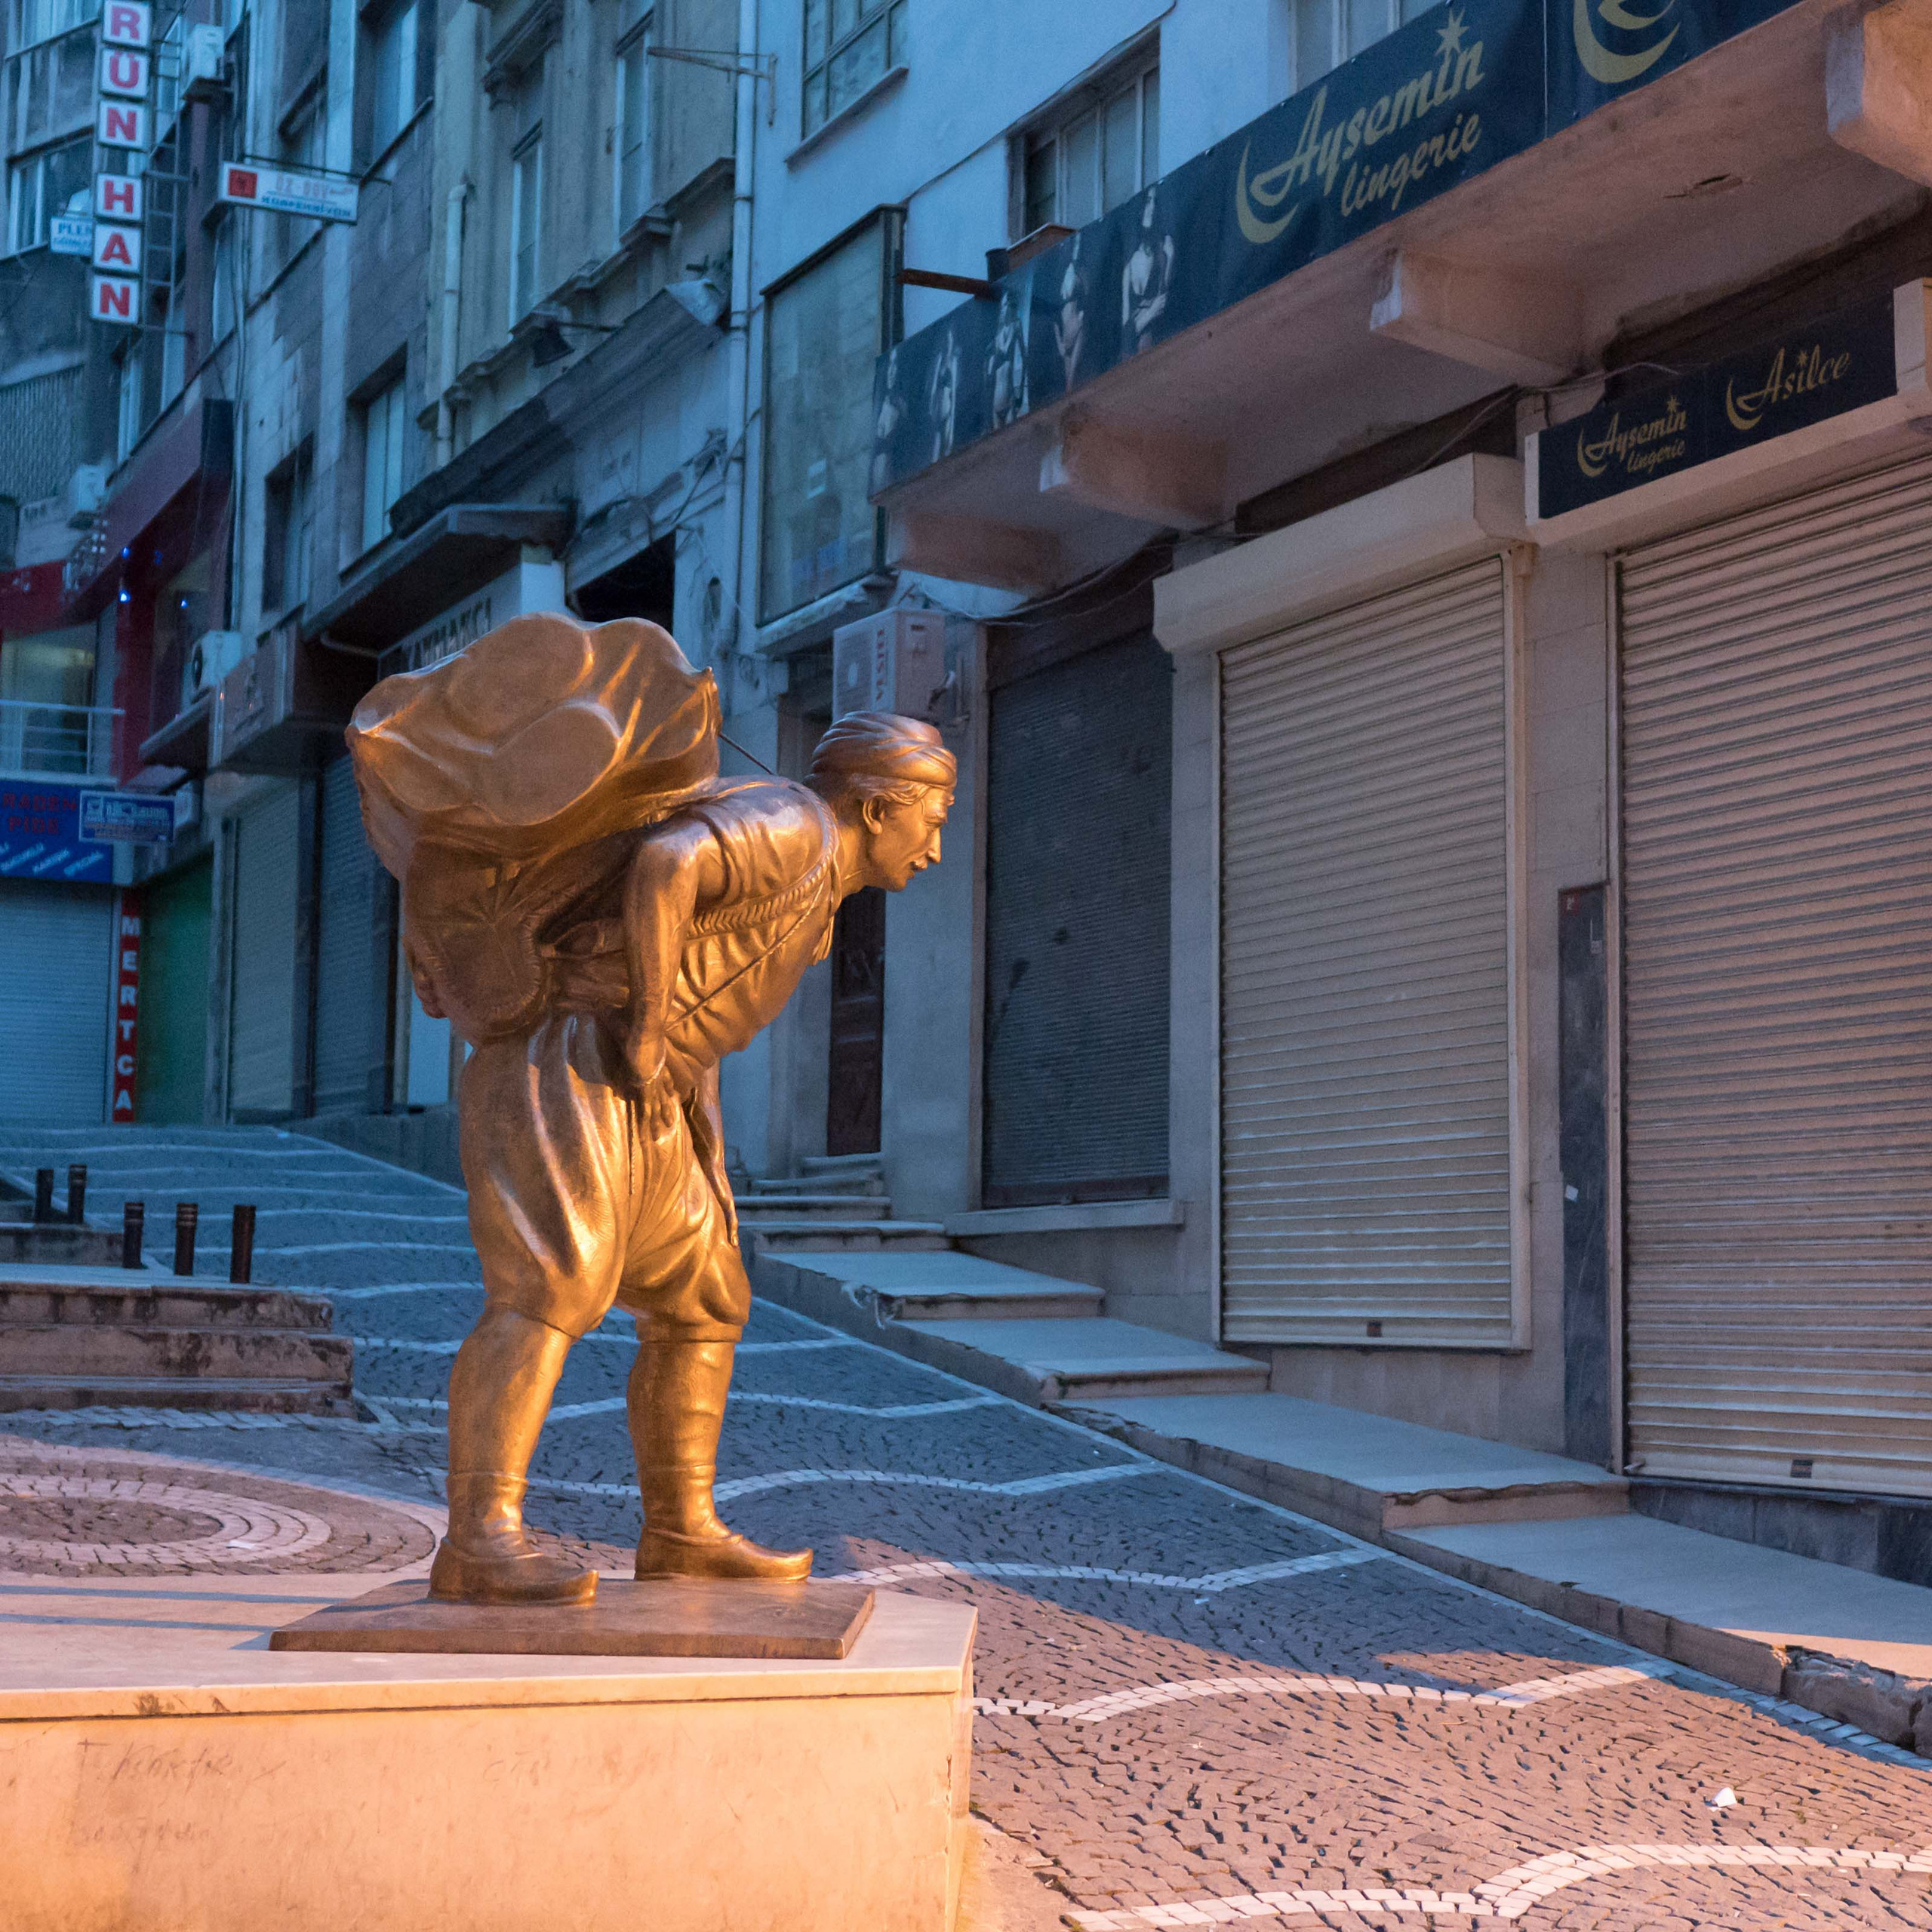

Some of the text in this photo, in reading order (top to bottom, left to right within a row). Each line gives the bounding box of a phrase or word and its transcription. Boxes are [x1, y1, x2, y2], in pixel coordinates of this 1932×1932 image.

[1249, 8, 1485, 206] Aysemin
[1341, 113, 1481, 217] lingerie
[99, 180, 134, 317] HAN
[1737, 345, 1850, 412] Asilce
[1586, 397, 1687, 462] Aysemin
[1627, 438, 1686, 474] lingerie
